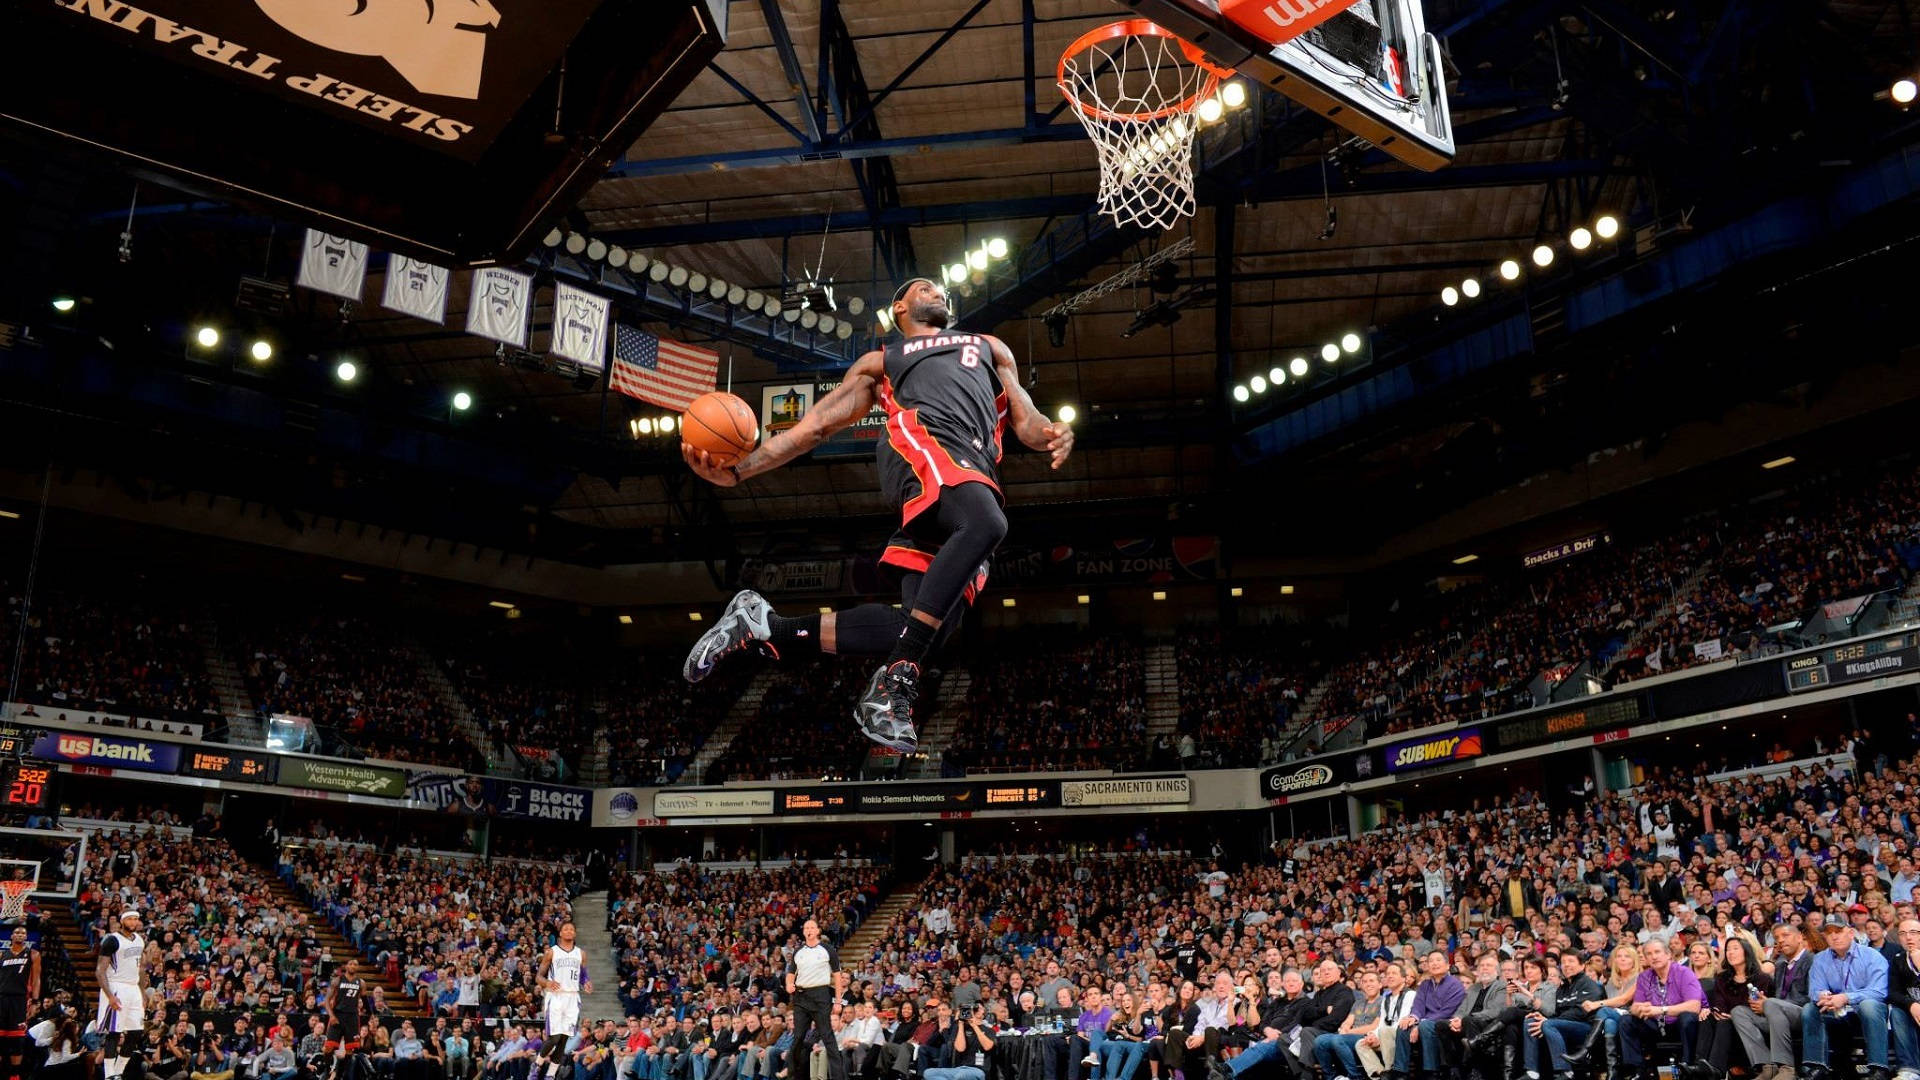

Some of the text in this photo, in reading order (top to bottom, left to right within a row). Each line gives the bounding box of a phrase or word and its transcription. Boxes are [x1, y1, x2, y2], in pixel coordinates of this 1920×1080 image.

[63, 0, 474, 141] SLEEP TRAIN
[903, 334, 981, 356] MIAMI
[960, 344, 980, 369] 6
[849, 416, 888, 427] EALS
[1523, 549, 1561, 567] Snacks
[1562, 545, 1571, 555] &
[1076, 556, 1174, 576] FAN ZONE
[1834, 645, 1865, 662] 5:22
[1791, 656, 1819, 670] KINGS
[1846, 655, 1903, 676] #KingsAllDay
[1810, 671, 1819, 684] 6
[0, 728, 21, 737] UEST
[1395, 736, 1461, 767] SUBWAY
[18, 768, 49, 783] 5:22
[304, 762, 376, 780] Western Health
[308, 774, 356, 789] Advantage
[1085, 780, 1187, 795] SACRAMENTO KINGS
[9, 781, 43, 805] 20
[530, 789, 584, 808] BLOCK
[862, 793, 946, 804] Nokia Siemens Networks
[528, 803, 584, 822] PARTY
[704, 800, 713, 808] TV
[720, 800, 744, 808] Internet
[751, 799, 771, 807] Phone
